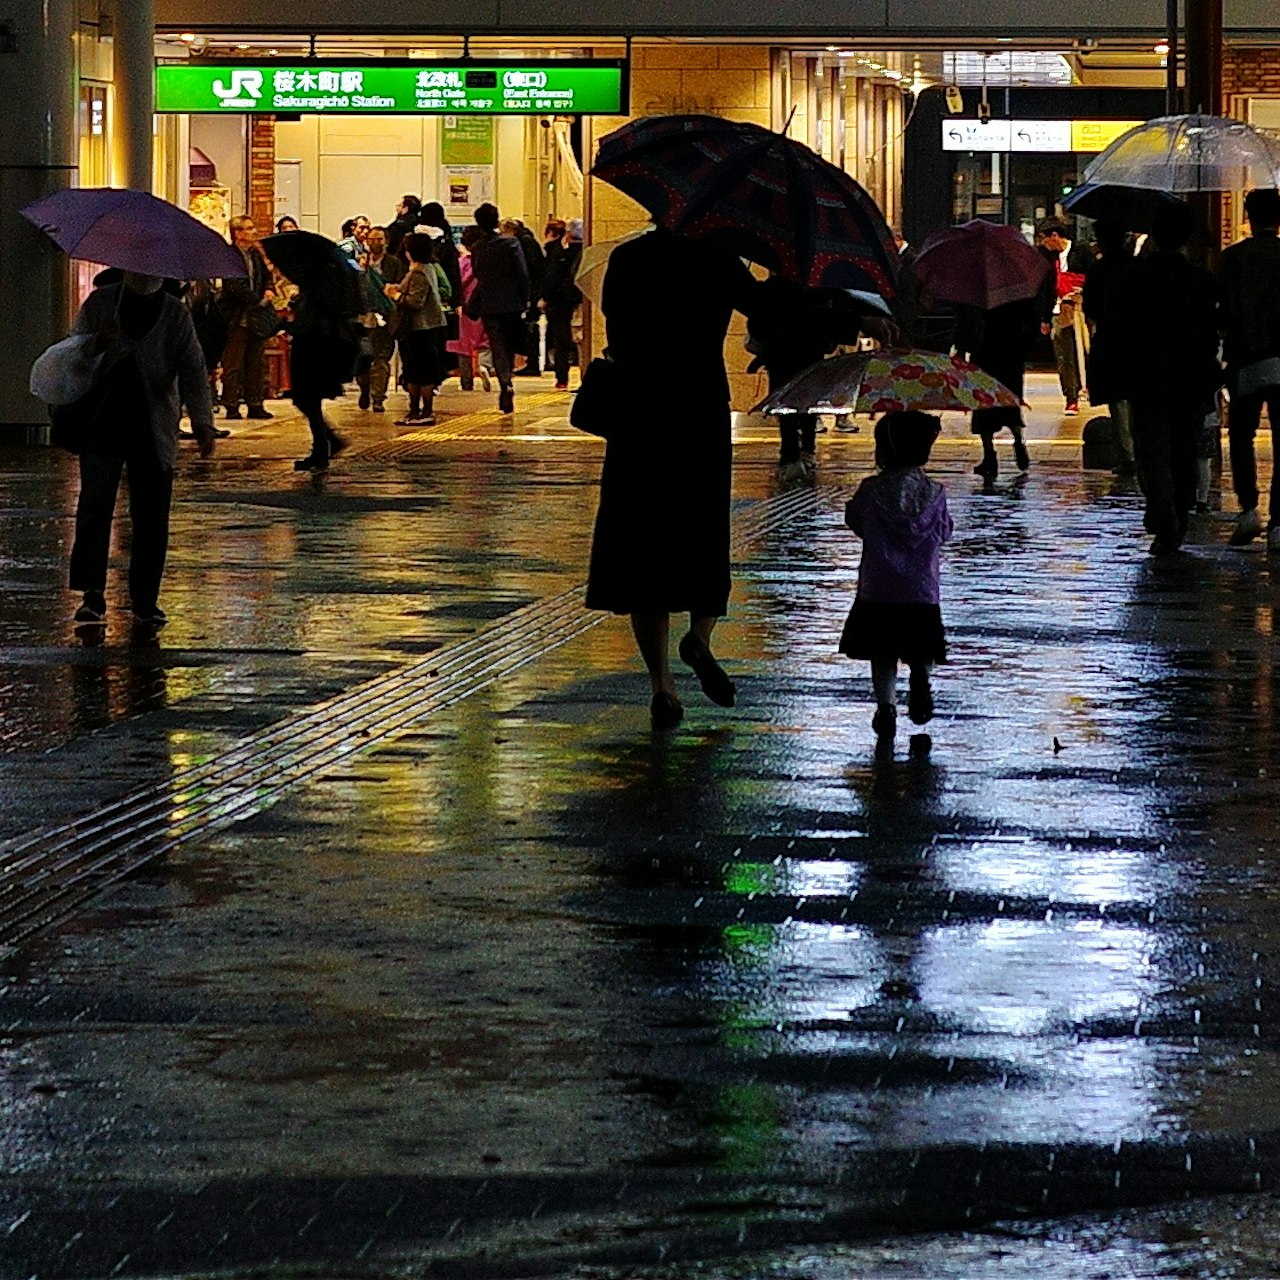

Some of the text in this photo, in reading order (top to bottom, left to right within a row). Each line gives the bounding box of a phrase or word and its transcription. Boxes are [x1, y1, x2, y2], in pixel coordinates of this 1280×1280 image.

[212, 70, 263, 99] JR
[272, 70, 363, 93] 桜木町駅
[351, 94, 395, 107] Station
